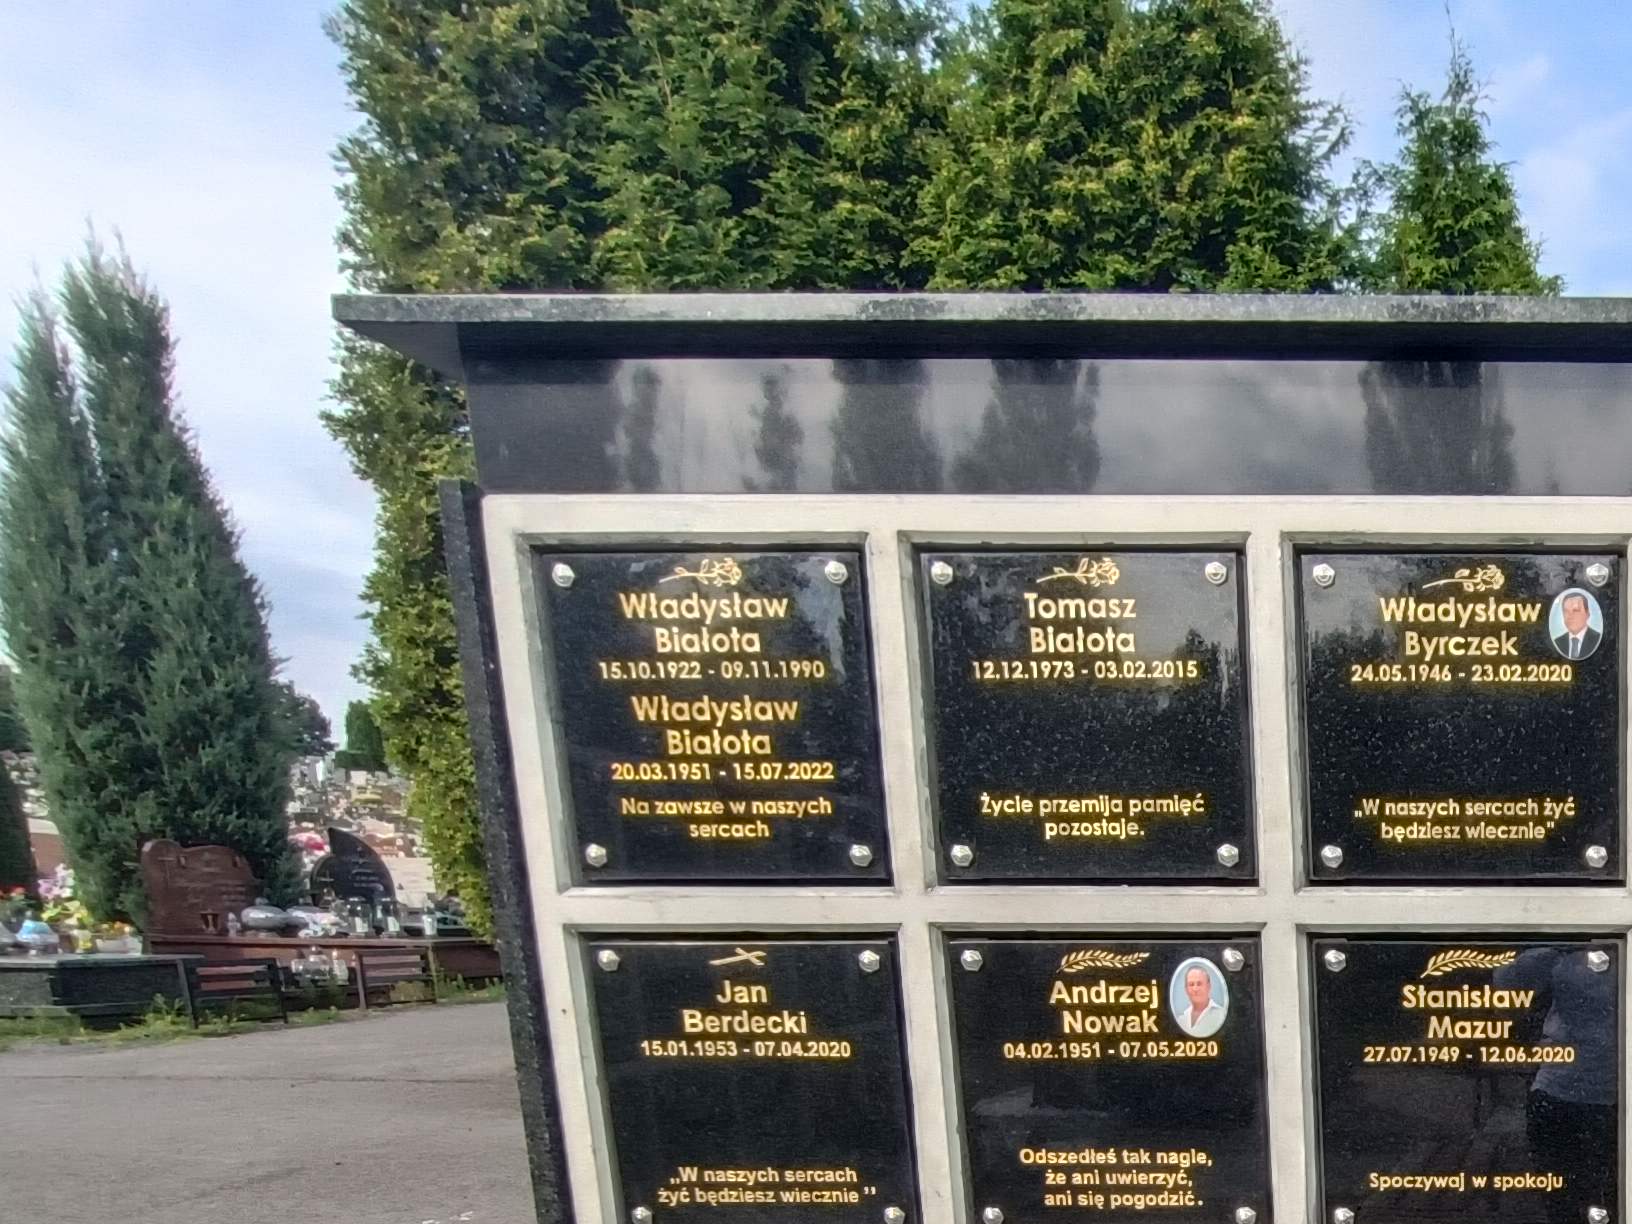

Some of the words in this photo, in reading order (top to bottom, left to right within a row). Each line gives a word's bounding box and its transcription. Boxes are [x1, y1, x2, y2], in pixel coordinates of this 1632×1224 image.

[620, 592, 788, 624] Władysław
[1024, 593, 1136, 619] Tomasz
[1380, 598, 1541, 628] Władysław
[654, 626, 760, 653] Białota
[1030, 626, 1135, 654] Białota
[1405, 631, 1518, 661] Byrczek
[599, 661, 702, 679] 15.10.1922
[721, 661, 824, 679] 09.11.1990
[973, 661, 1074, 679] 12.12.1973
[1095, 660, 1197, 679] 03.02.2015
[1351, 664, 1451, 682] 24.05.1946
[1472, 664, 1572, 681] 23.02.2020
[631, 695, 798, 727] Władysław
[667, 729, 771, 755] Białota
[611, 763, 710, 780] 20.03.1951
[733, 762, 834, 780] 15.07.2022
[981, 792, 1033, 816] Życie
[1040, 795, 1122, 816] przemija
[1129, 793, 1204, 816] pamięć
[1385, 799, 1459, 819] naszych
[1465, 798, 1538, 815] sercach
[1544, 797, 1575, 819] żyć
[1045, 818, 1144, 839] pozostaje.
[1382, 822, 1460, 843] będziesz
[717, 980, 767, 1003] Jan
[1050, 980, 1158, 1009] Andrzej
[1403, 985, 1534, 1008] Stanisław
[683, 1010, 807, 1033] Berdecki
[1063, 1010, 1158, 1033] Nowak
[1428, 1016, 1512, 1038] Mazur
[641, 1040, 737, 1056] 15.01.1953
[755, 1041, 850, 1057] 07.04.2020
[1004, 1042, 1100, 1058] 04.02.1951
[1120, 1041, 1217, 1057] 07.05.2020
[1364, 1047, 1459, 1062] 27.07.1949
[1480, 1047, 1574, 1062] 12.06.2020
[1020, 1148, 1117, 1164] Odszedłeś
[1122, 1149, 1151, 1164] tak
[1157, 1149, 1212, 1168] nagle,
[1046, 1169, 1066, 1184] że
[1072, 1169, 1099, 1184] ani
[1106, 1169, 1192, 1188] uwierzyć,
[1370, 1173, 1464, 1191] Spoczywaj
[1472, 1176, 1487, 1187] w
[1494, 1173, 1562, 1191] spokoju
[1045, 1190, 1072, 1205] ani
[1078, 1191, 1104, 1209] się
[1110, 1191, 1203, 1209] pogodzić.
